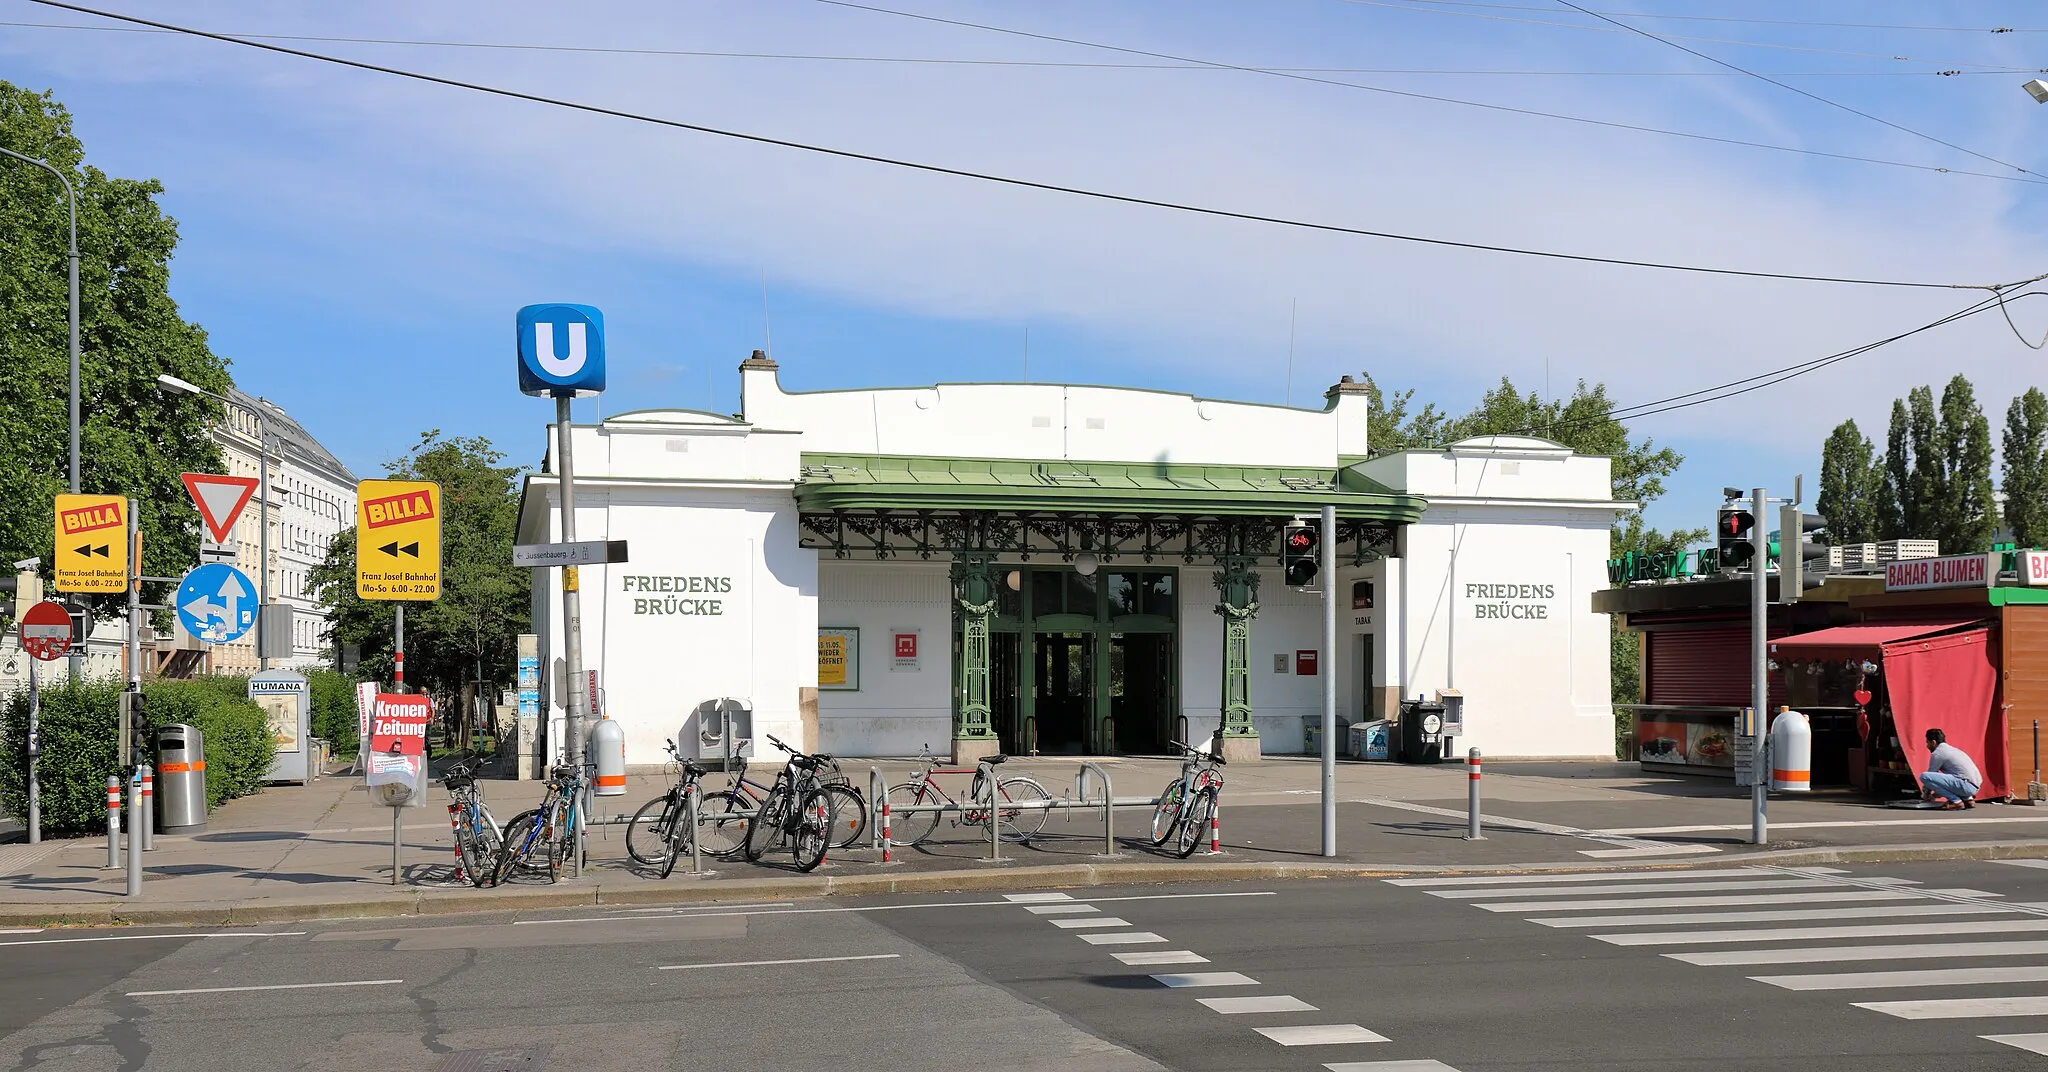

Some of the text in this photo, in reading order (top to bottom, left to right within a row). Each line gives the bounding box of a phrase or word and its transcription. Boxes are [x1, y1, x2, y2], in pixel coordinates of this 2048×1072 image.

[535, 322, 587, 377] U
[64, 507, 119, 531] BILLA
[367, 496, 431, 524] BILLA
[59, 569, 124, 578] Franz Josef Bahnhof
[361, 571, 436, 581] Franz Josef Bahnhof
[1888, 557, 1985, 587] BAHAR BLUMEN
[362, 583, 387, 592] Mo-So
[391, 585, 408, 593] 6.00
[414, 585, 435, 593] 22.00
[623, 575, 732, 593] FRIEDENS
[1465, 583, 1555, 599] FRIEDENS
[634, 594, 723, 616] BRÜCKE
[1475, 600, 1548, 619] BRÜCKE
[1355, 615, 1371, 625] TABAK
[818, 649, 840, 657] WIEDER
[818, 656, 843, 665] EÖFFNET
[252, 682, 301, 690] HUMANA
[375, 700, 427, 718] Kronen
[374, 719, 427, 738] Zeitung
